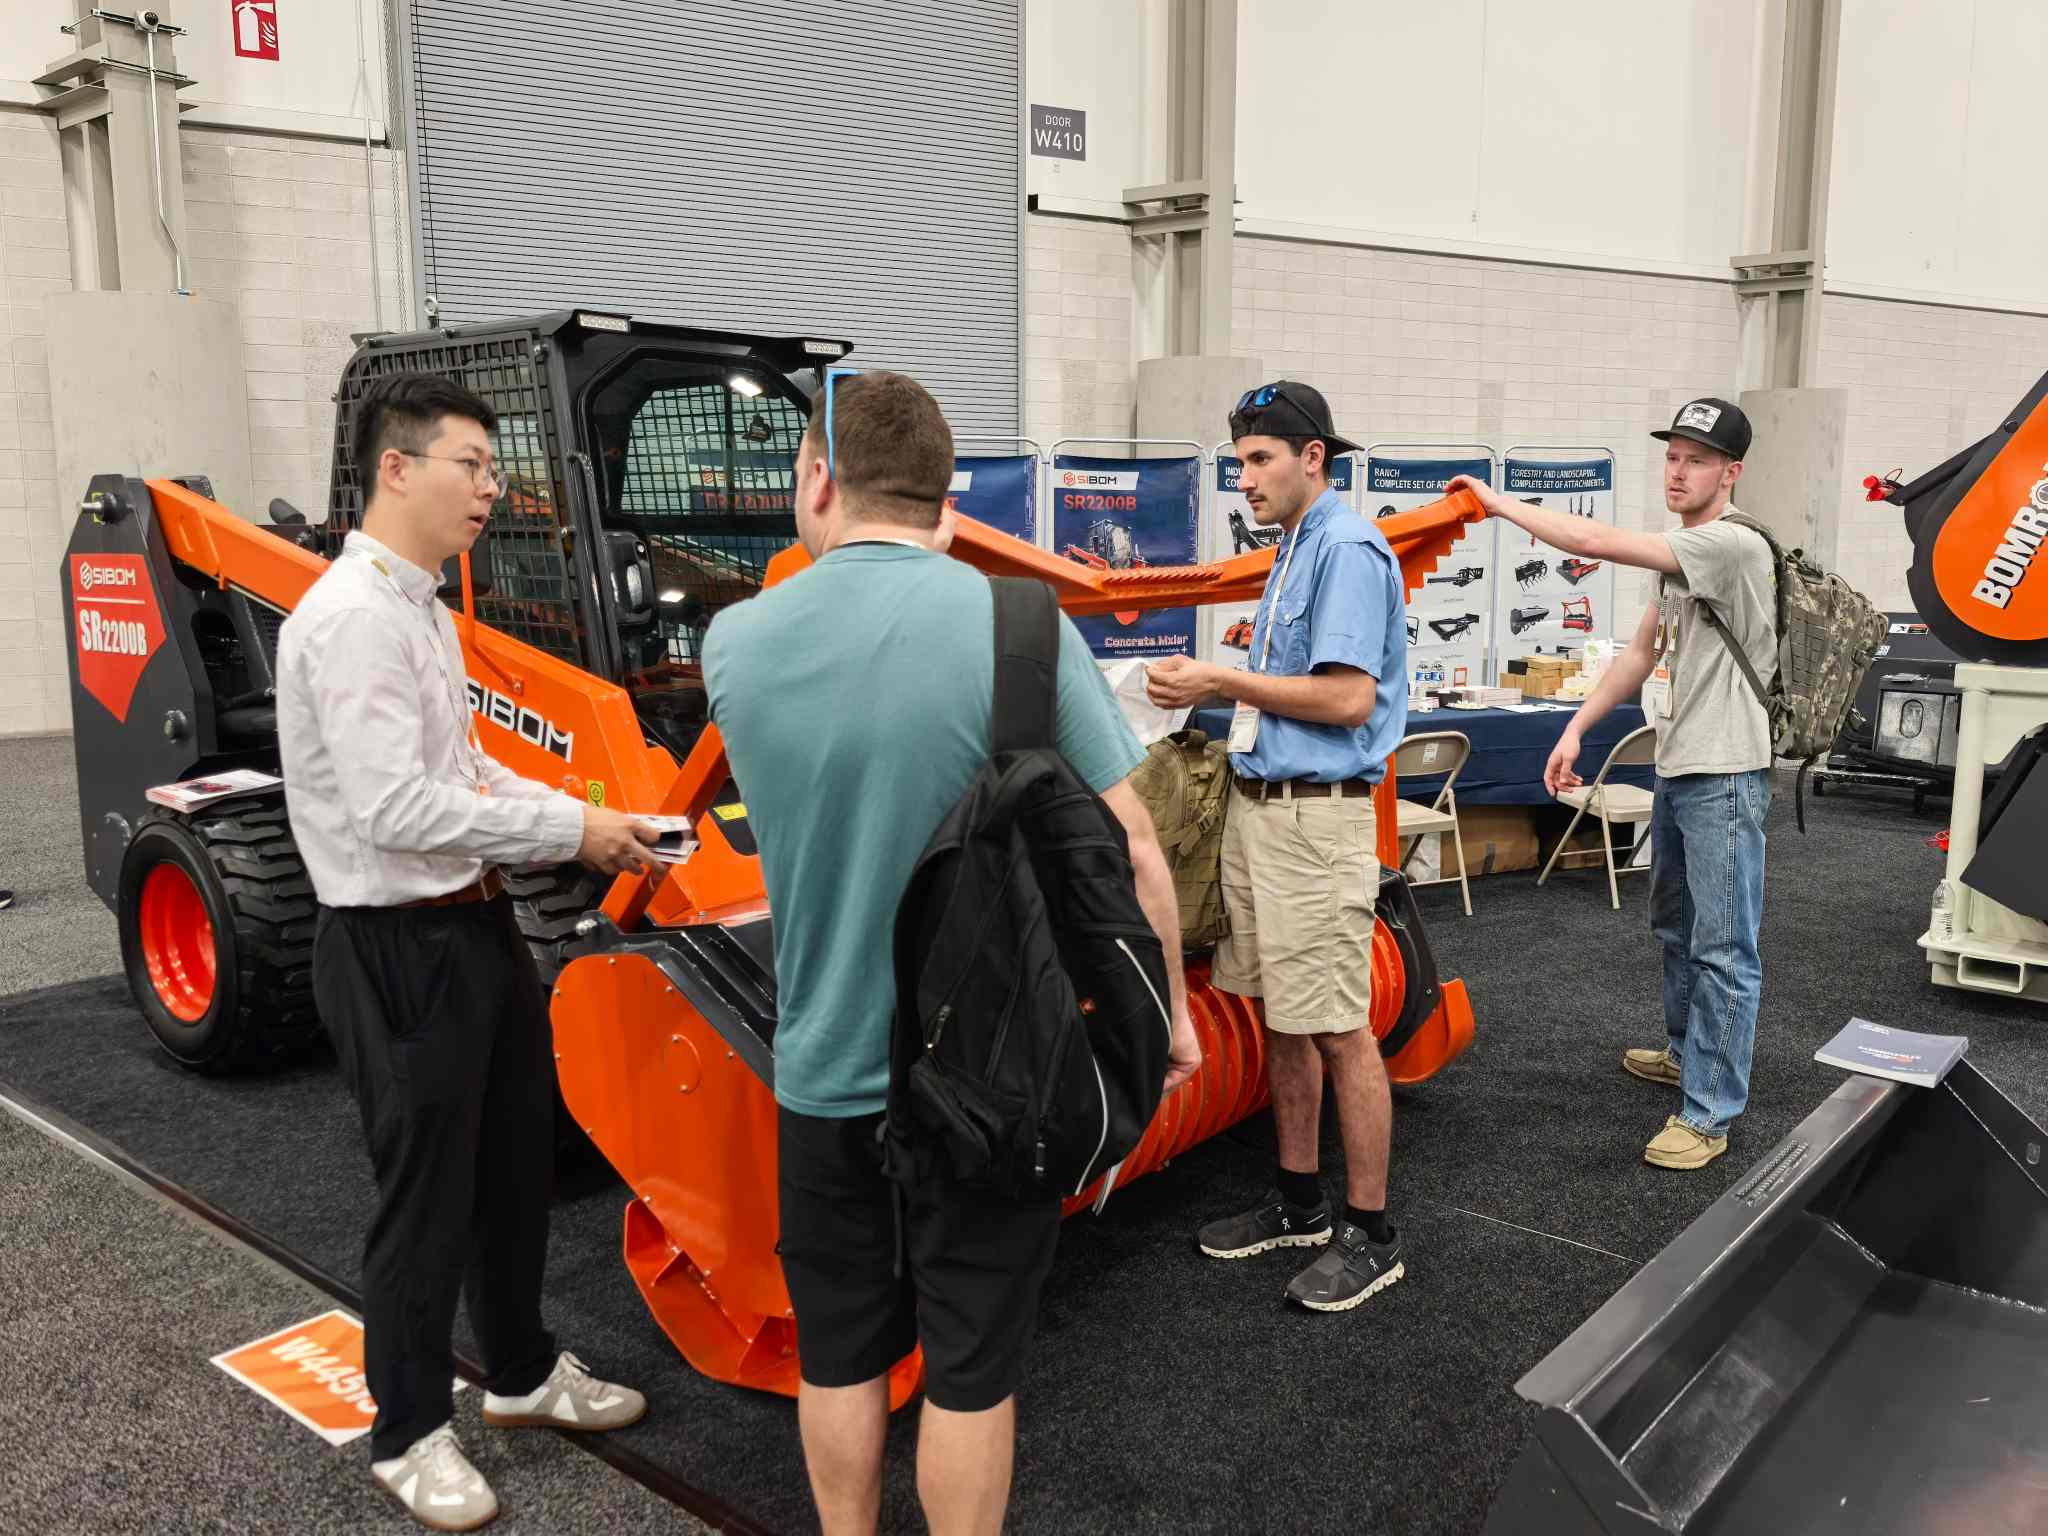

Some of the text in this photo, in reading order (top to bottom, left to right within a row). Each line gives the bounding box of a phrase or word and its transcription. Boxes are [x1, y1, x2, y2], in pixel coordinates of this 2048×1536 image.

[1045, 114, 1072, 128] DOOR
[1034, 128, 1083, 152] W410
[1374, 467, 1400, 477] RANCH
[1511, 468, 1596, 478] FORESTRY AND LANDSCAPING
[1077, 474, 1117, 485] SIBOM
[1374, 479, 1412, 489] COMPLETE
[1412, 480, 1424, 489] SET
[1426, 480, 1436, 489] OF
[1511, 478, 1605, 488] COMPLETE SET OF ATTACHMENTS
[1063, 494, 1137, 511] SR2200B
[1971, 461, 2048, 609] BOMR
[93, 567, 137, 586] SIBOM
[79, 608, 147, 656] SR2200B
